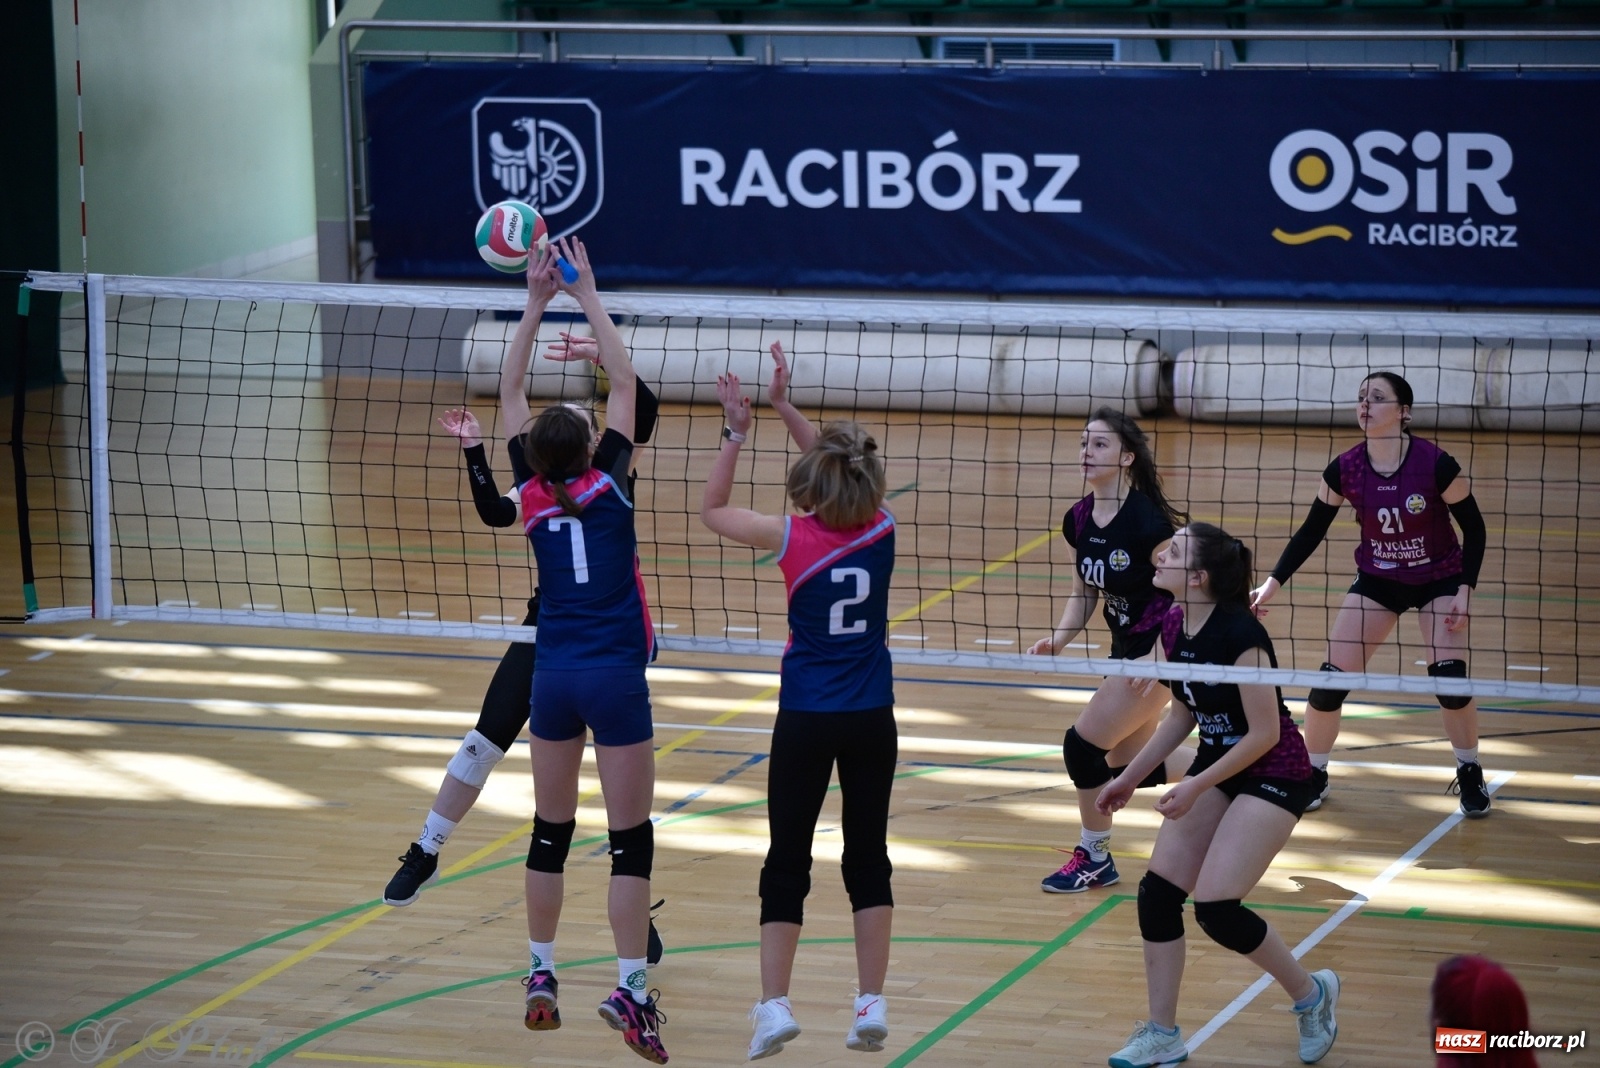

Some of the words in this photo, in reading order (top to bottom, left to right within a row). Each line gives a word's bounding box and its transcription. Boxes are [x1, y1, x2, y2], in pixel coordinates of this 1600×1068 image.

[681, 130, 1082, 213] RACIBÓRZ
[507, 212, 520, 242] molten
[1368, 217, 1518, 247] RACIBÓRZ
[1377, 507, 1404, 534] 21
[548, 516, 589, 584] 7
[1372, 547, 1427, 560] KRAPKOWICE
[1384, 535, 1425, 551] VOLLEY
[1081, 556, 1105, 589] 20
[829, 567, 871, 635] 2
